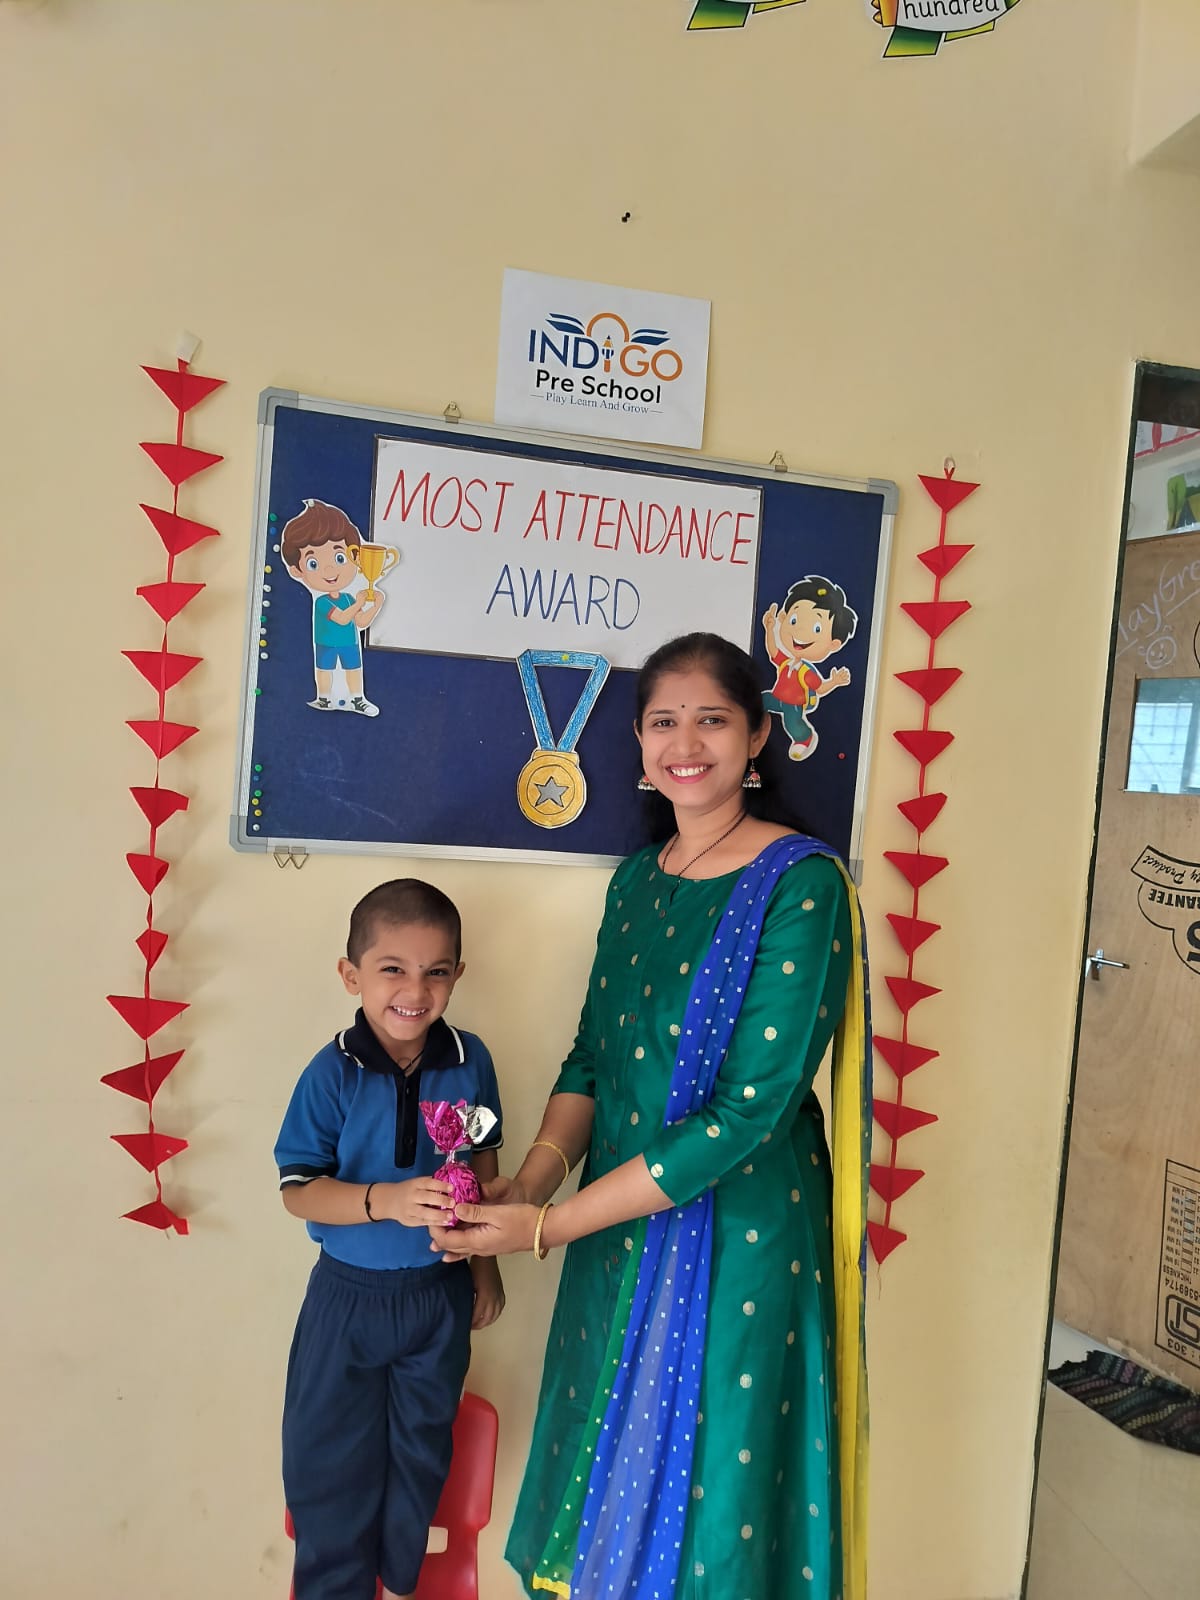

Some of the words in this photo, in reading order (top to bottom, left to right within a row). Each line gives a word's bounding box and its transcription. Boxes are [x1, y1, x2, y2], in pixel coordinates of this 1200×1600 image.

[536, 369, 574, 393] Pre
[581, 375, 661, 404] School
[546, 392, 567, 405] Play
[570, 395, 597, 408] Learn
[599, 400, 620, 411] And
[622, 402, 649, 414] Grow
[382, 469, 514, 533] MOST
[523, 489, 755, 565] ATTENDANCE
[486, 563, 641, 630] AWARD
